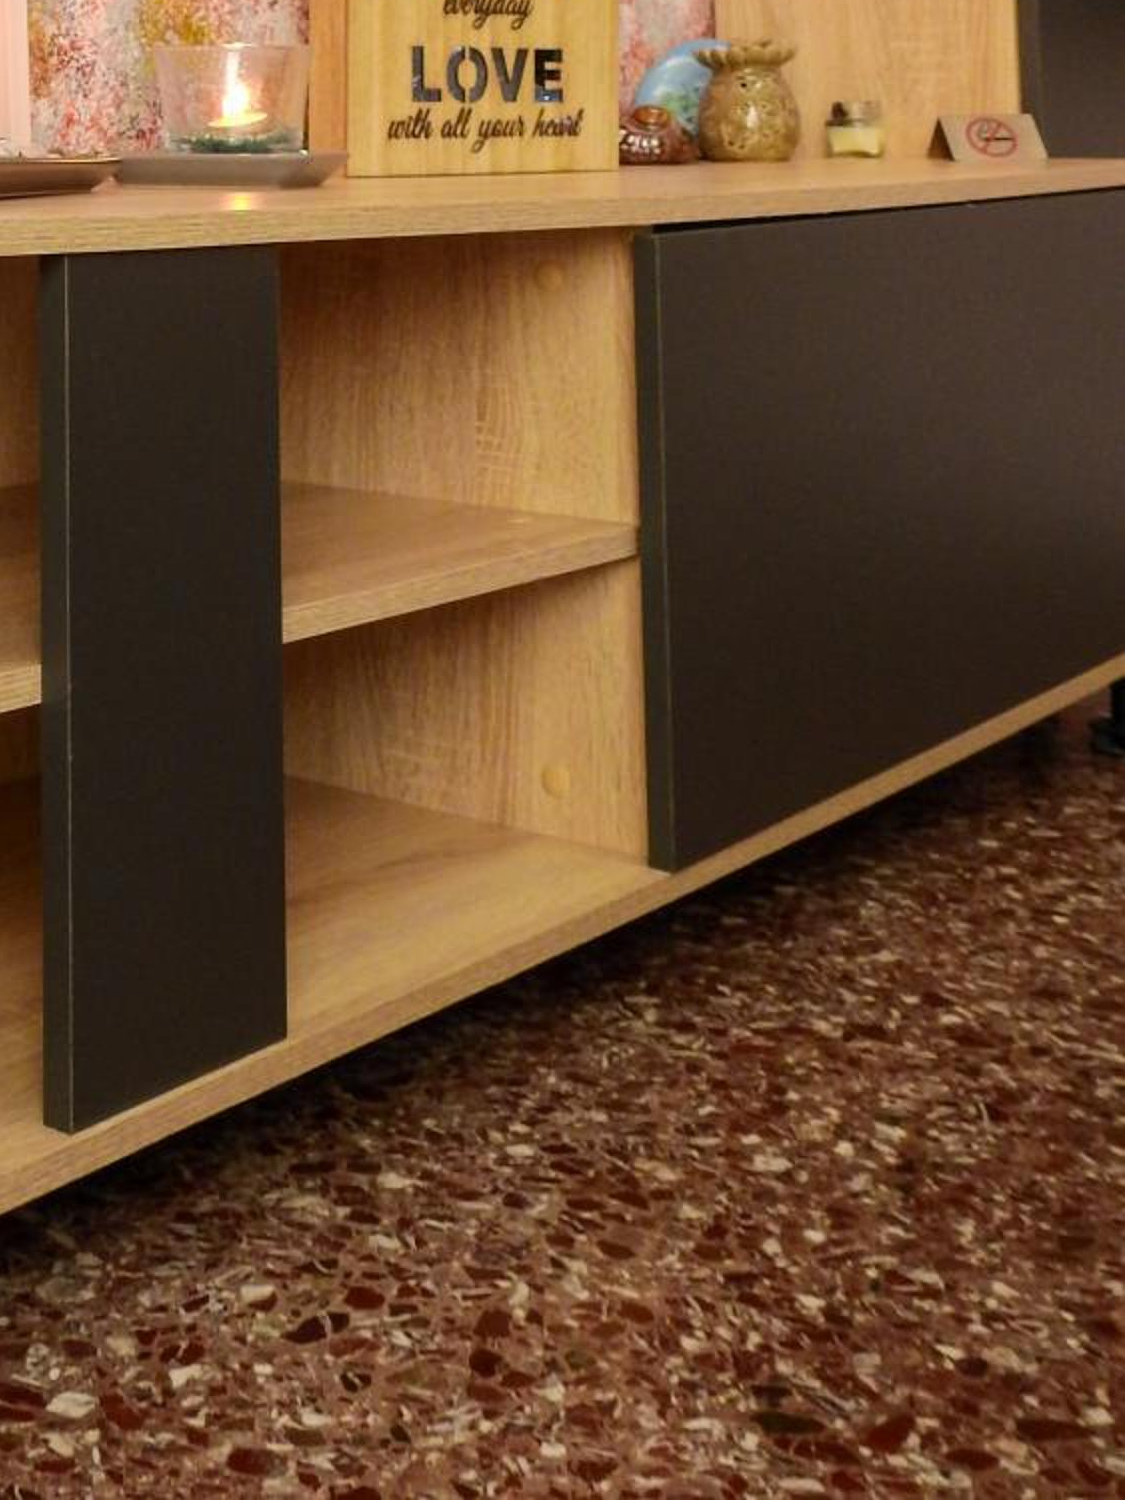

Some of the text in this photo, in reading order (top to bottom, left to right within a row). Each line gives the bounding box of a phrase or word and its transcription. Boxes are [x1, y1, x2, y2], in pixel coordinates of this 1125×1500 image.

[411, 45, 565, 104] LOVE
[387, 107, 586, 153] with all your heart
